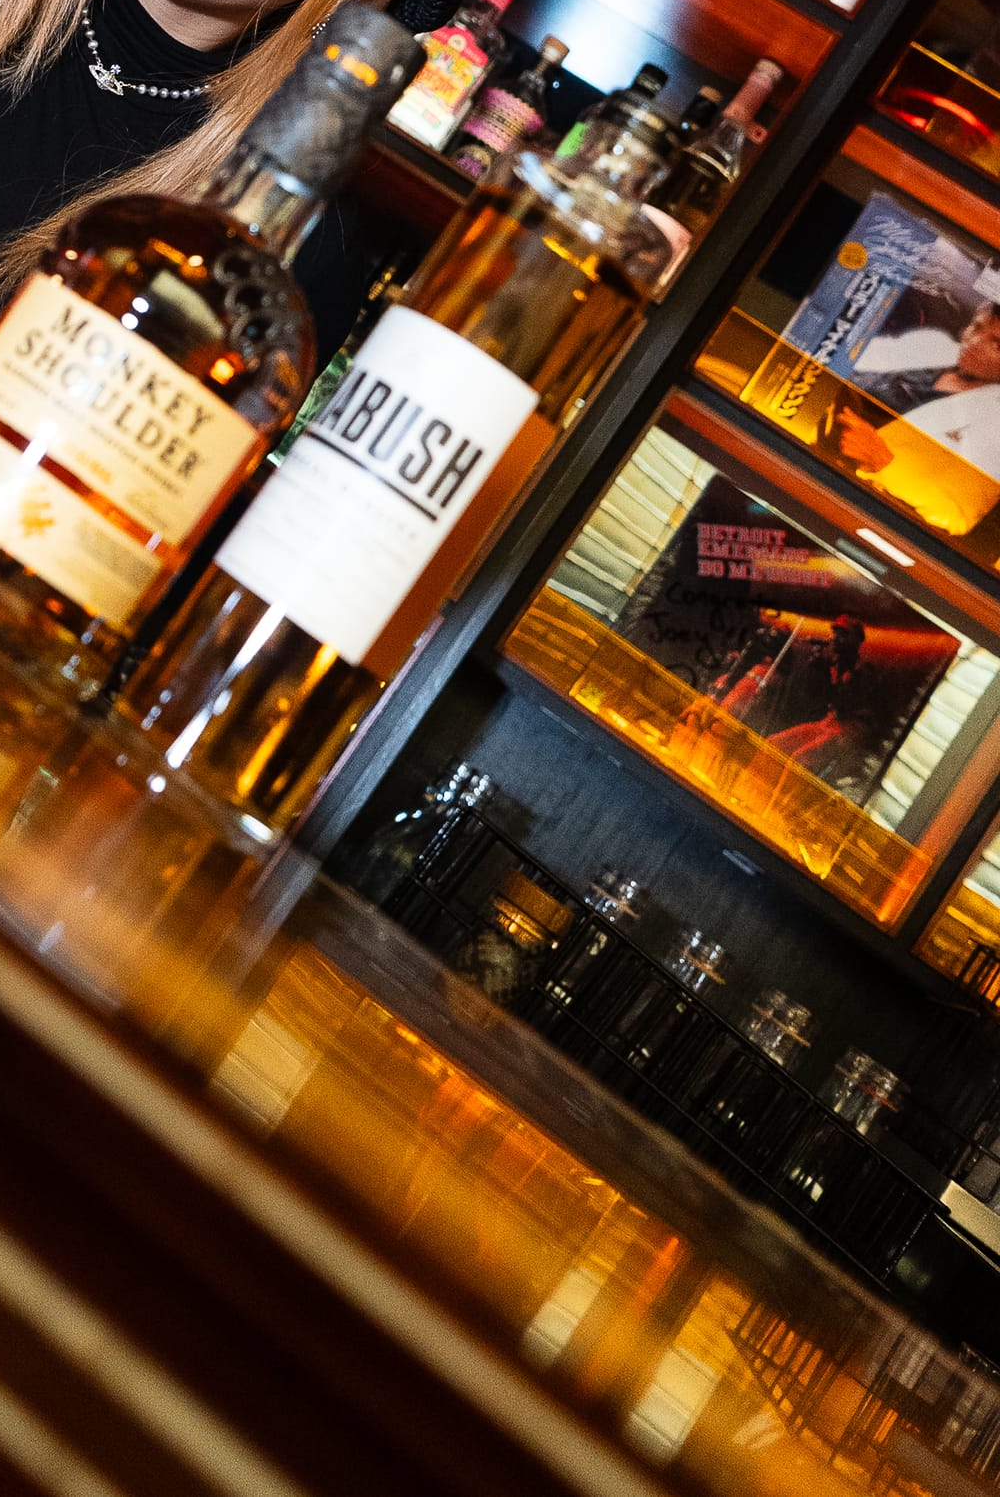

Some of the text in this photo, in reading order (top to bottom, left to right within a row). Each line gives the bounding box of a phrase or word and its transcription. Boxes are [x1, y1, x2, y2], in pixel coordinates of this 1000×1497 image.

[15, 327, 203, 480] SHOULDER
[52, 305, 215, 435] MONKEY
[697, 522, 788, 546] DETROIT
